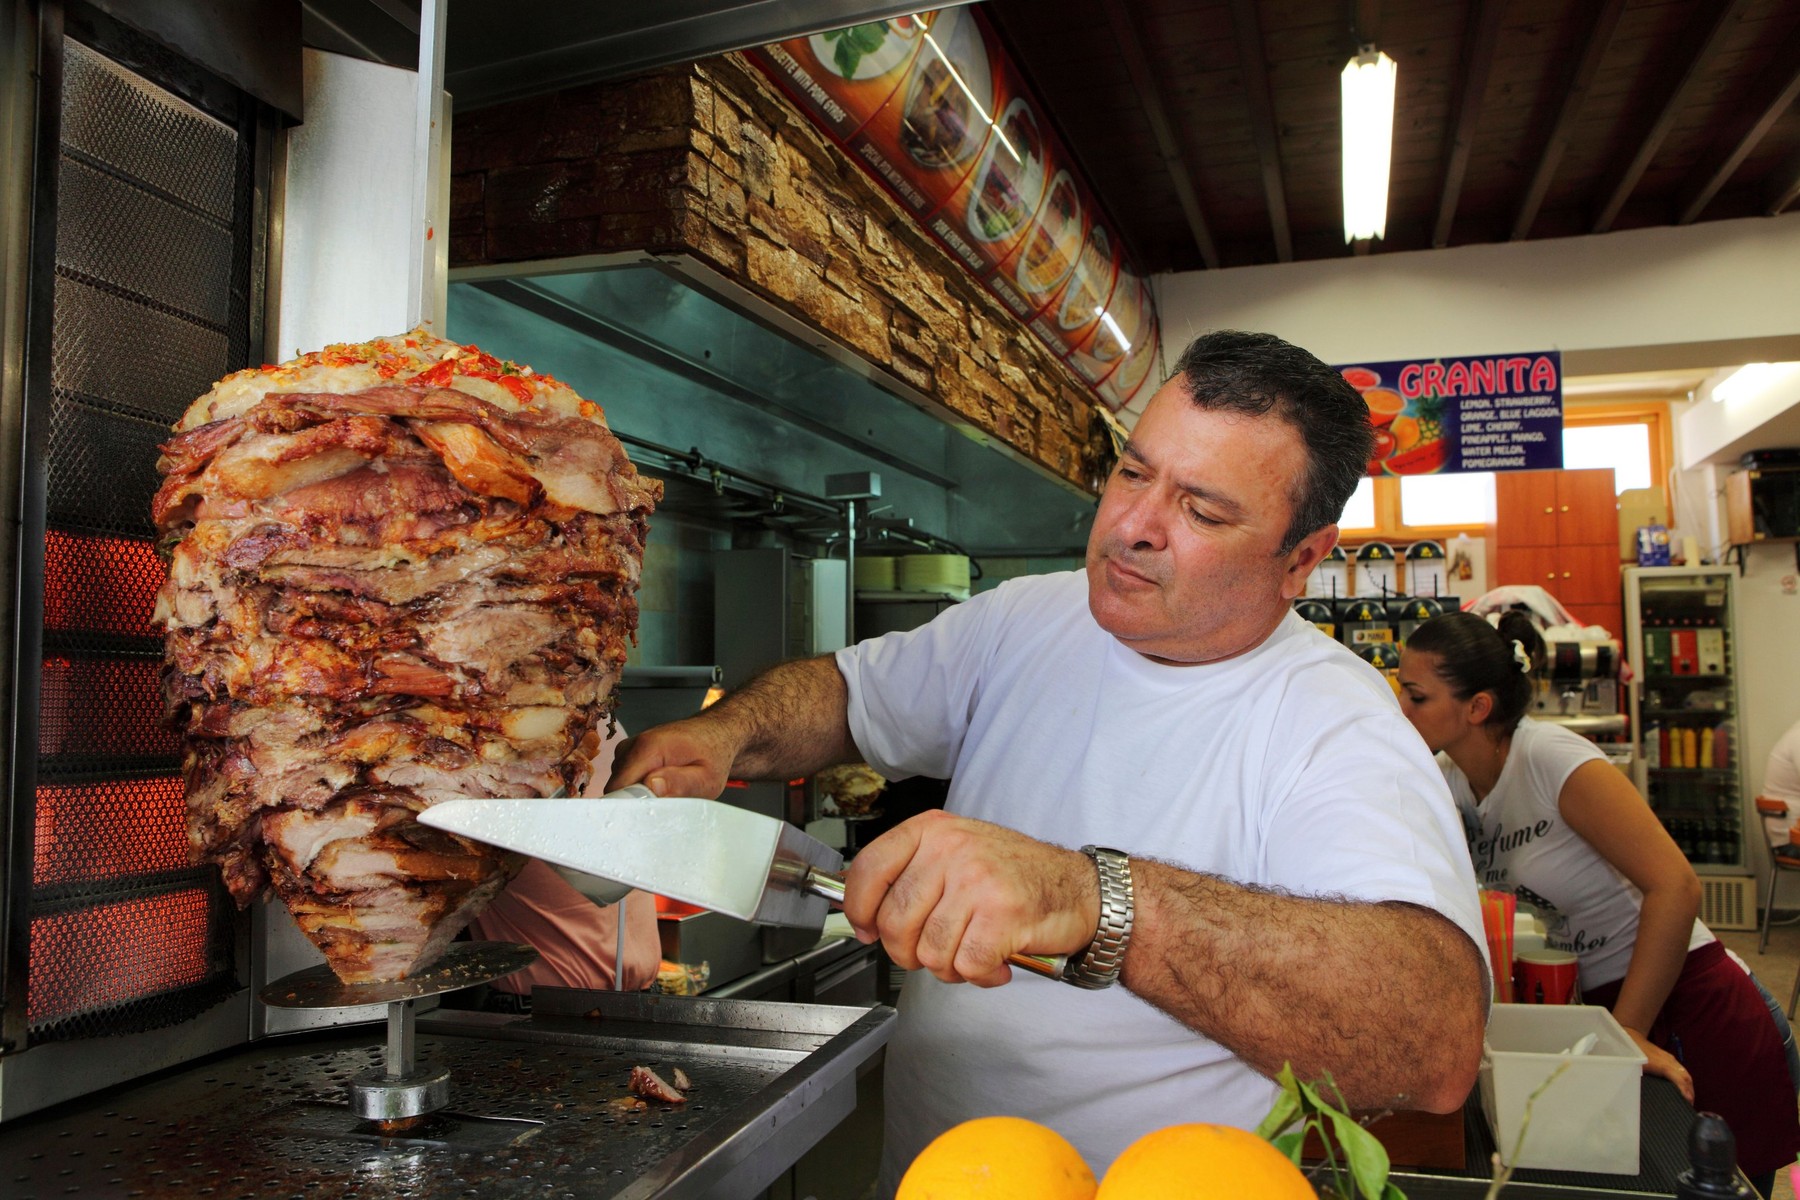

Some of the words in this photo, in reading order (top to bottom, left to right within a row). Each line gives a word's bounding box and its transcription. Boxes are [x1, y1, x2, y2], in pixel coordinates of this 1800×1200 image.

[792, 67, 814, 90] WITH
[807, 83, 829, 105] PORK
[823, 99, 847, 123] GYROS
[1398, 356, 1557, 398] GRANITA
[1499, 409, 1521, 419] BLUE
[1461, 446, 1492, 456] WATER
[1485, 867, 1508, 882] me
